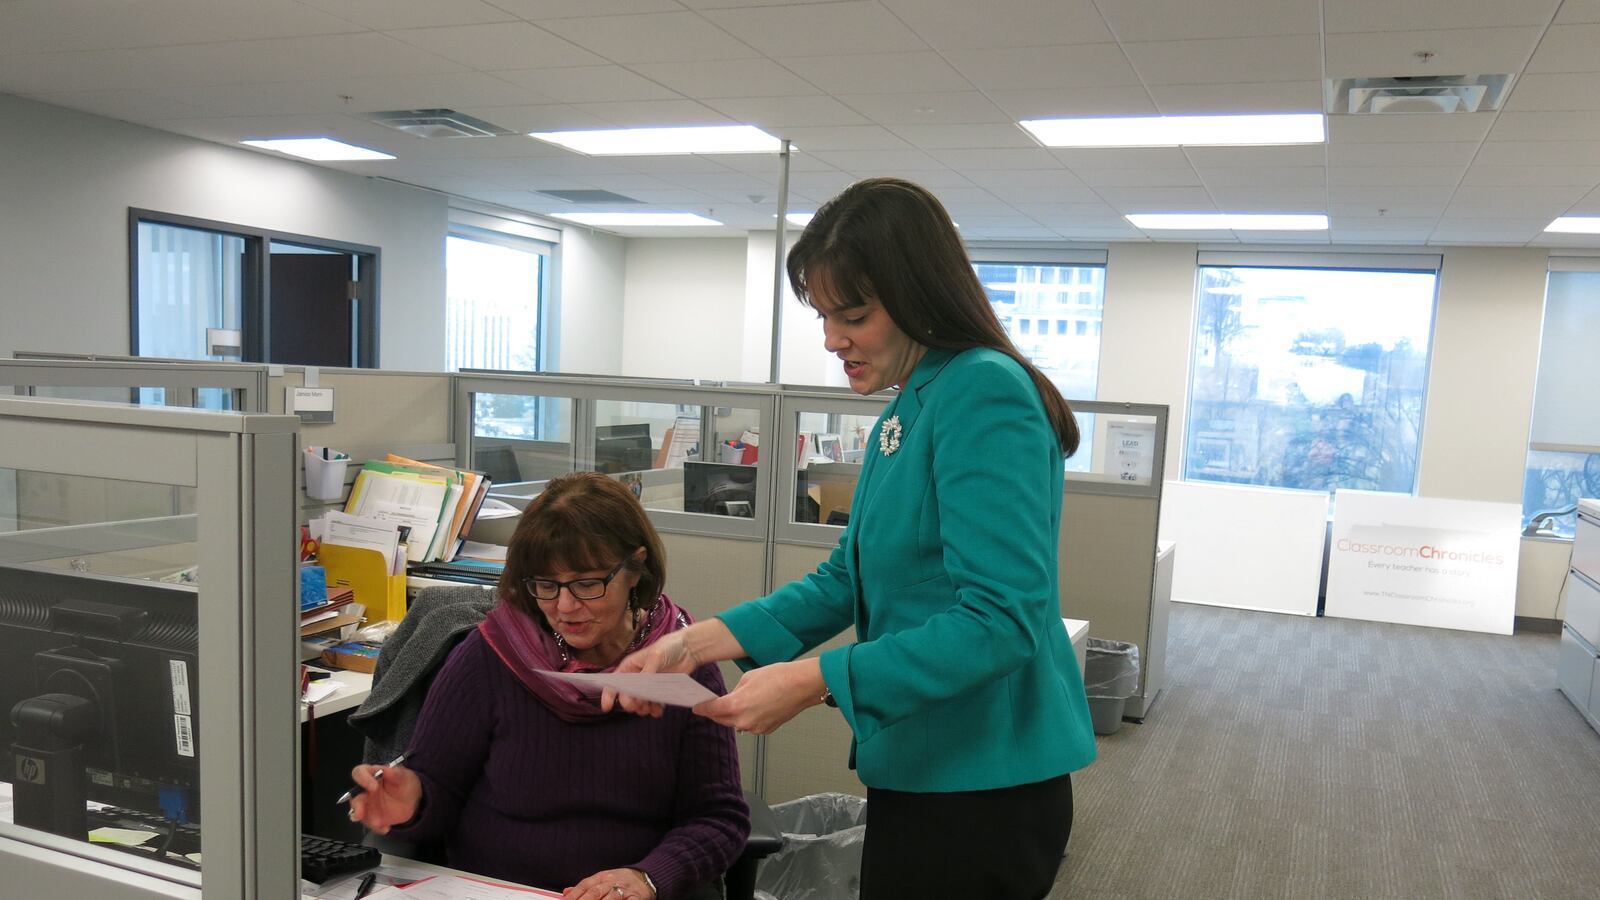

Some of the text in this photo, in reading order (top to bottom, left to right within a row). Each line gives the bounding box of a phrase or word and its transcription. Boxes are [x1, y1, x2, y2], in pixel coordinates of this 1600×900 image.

[1336, 538, 1505, 565] ClassroomChronicles
[1367, 560, 1390, 571] Every
[1392, 563, 1423, 573] teacher
[1425, 567, 1440, 575] has
[22, 758, 37, 780] hp
